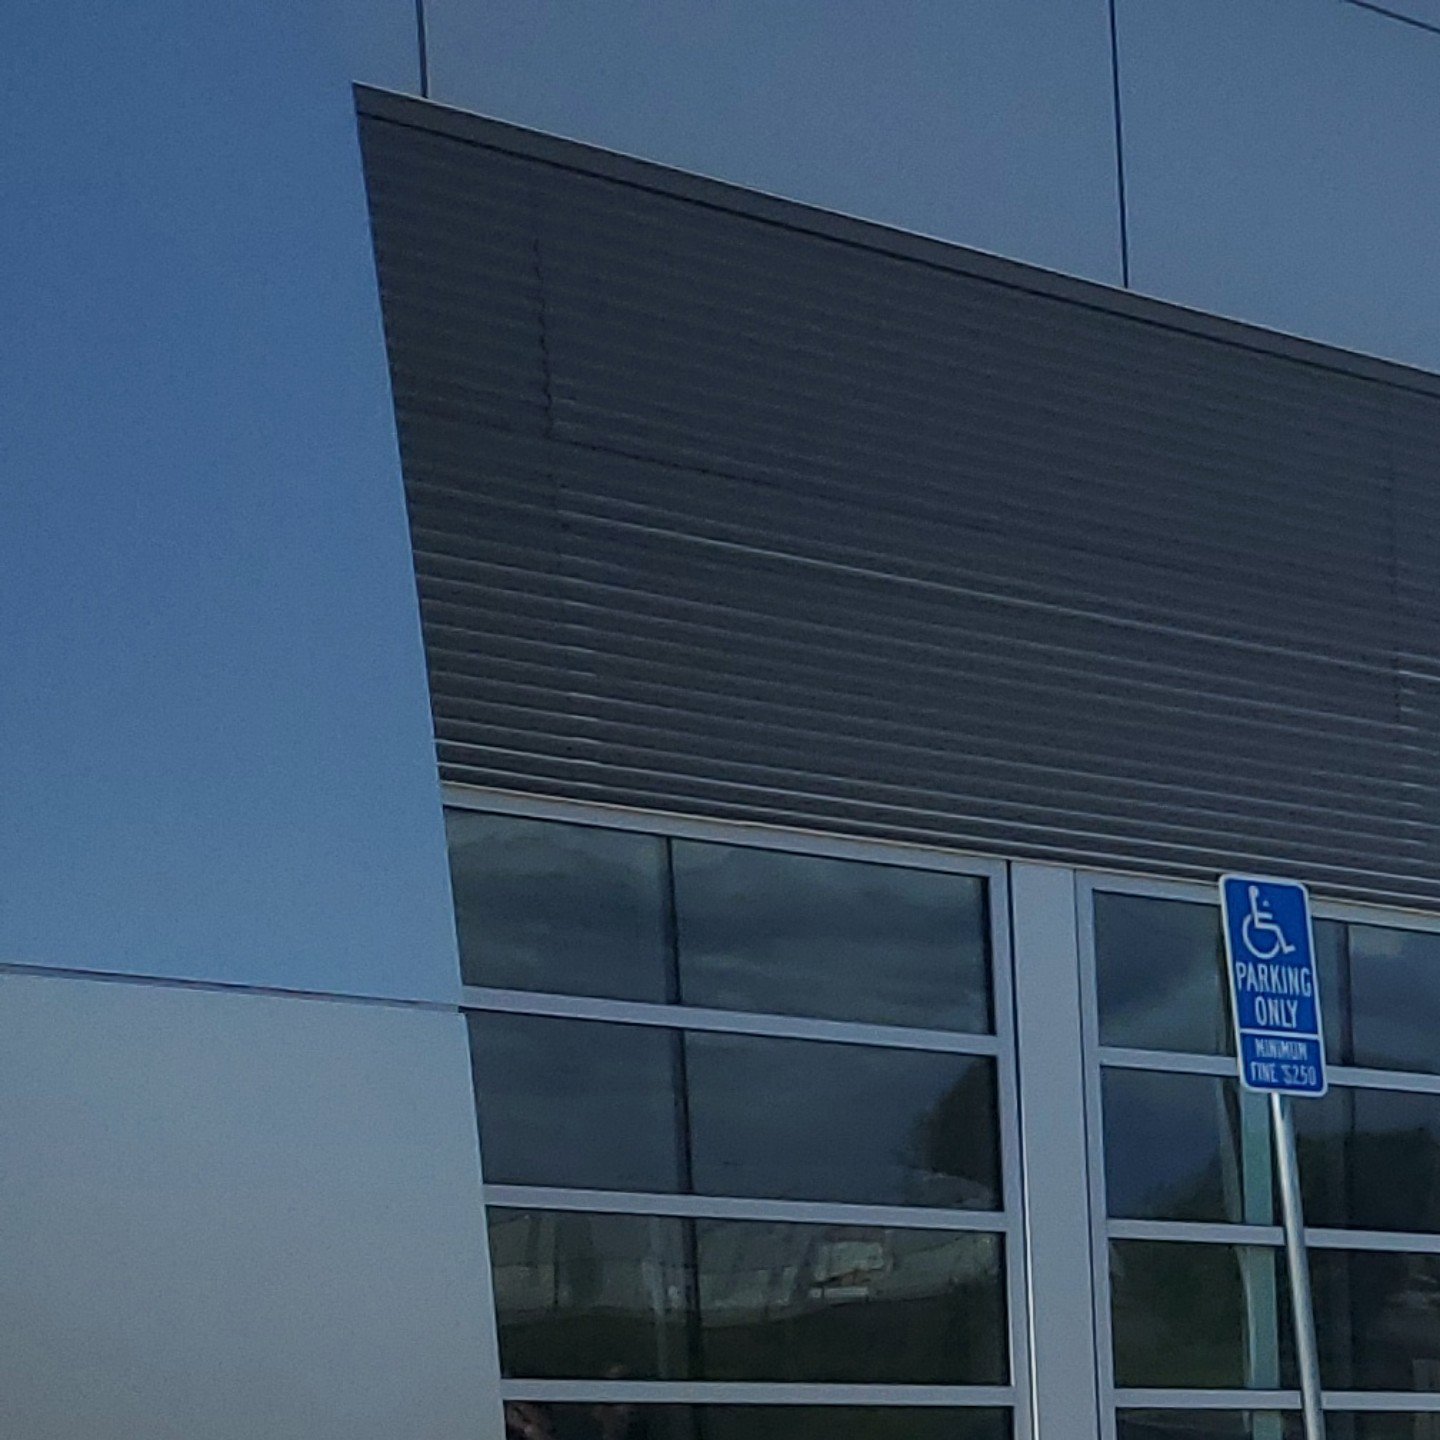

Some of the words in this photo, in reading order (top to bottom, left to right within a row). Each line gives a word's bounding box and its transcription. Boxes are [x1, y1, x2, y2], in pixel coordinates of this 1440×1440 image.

[1235, 961, 1312, 997] PARKING
[1255, 996, 1298, 1028] ONLY
[1255, 1038, 1308, 1061] MINIMUM
